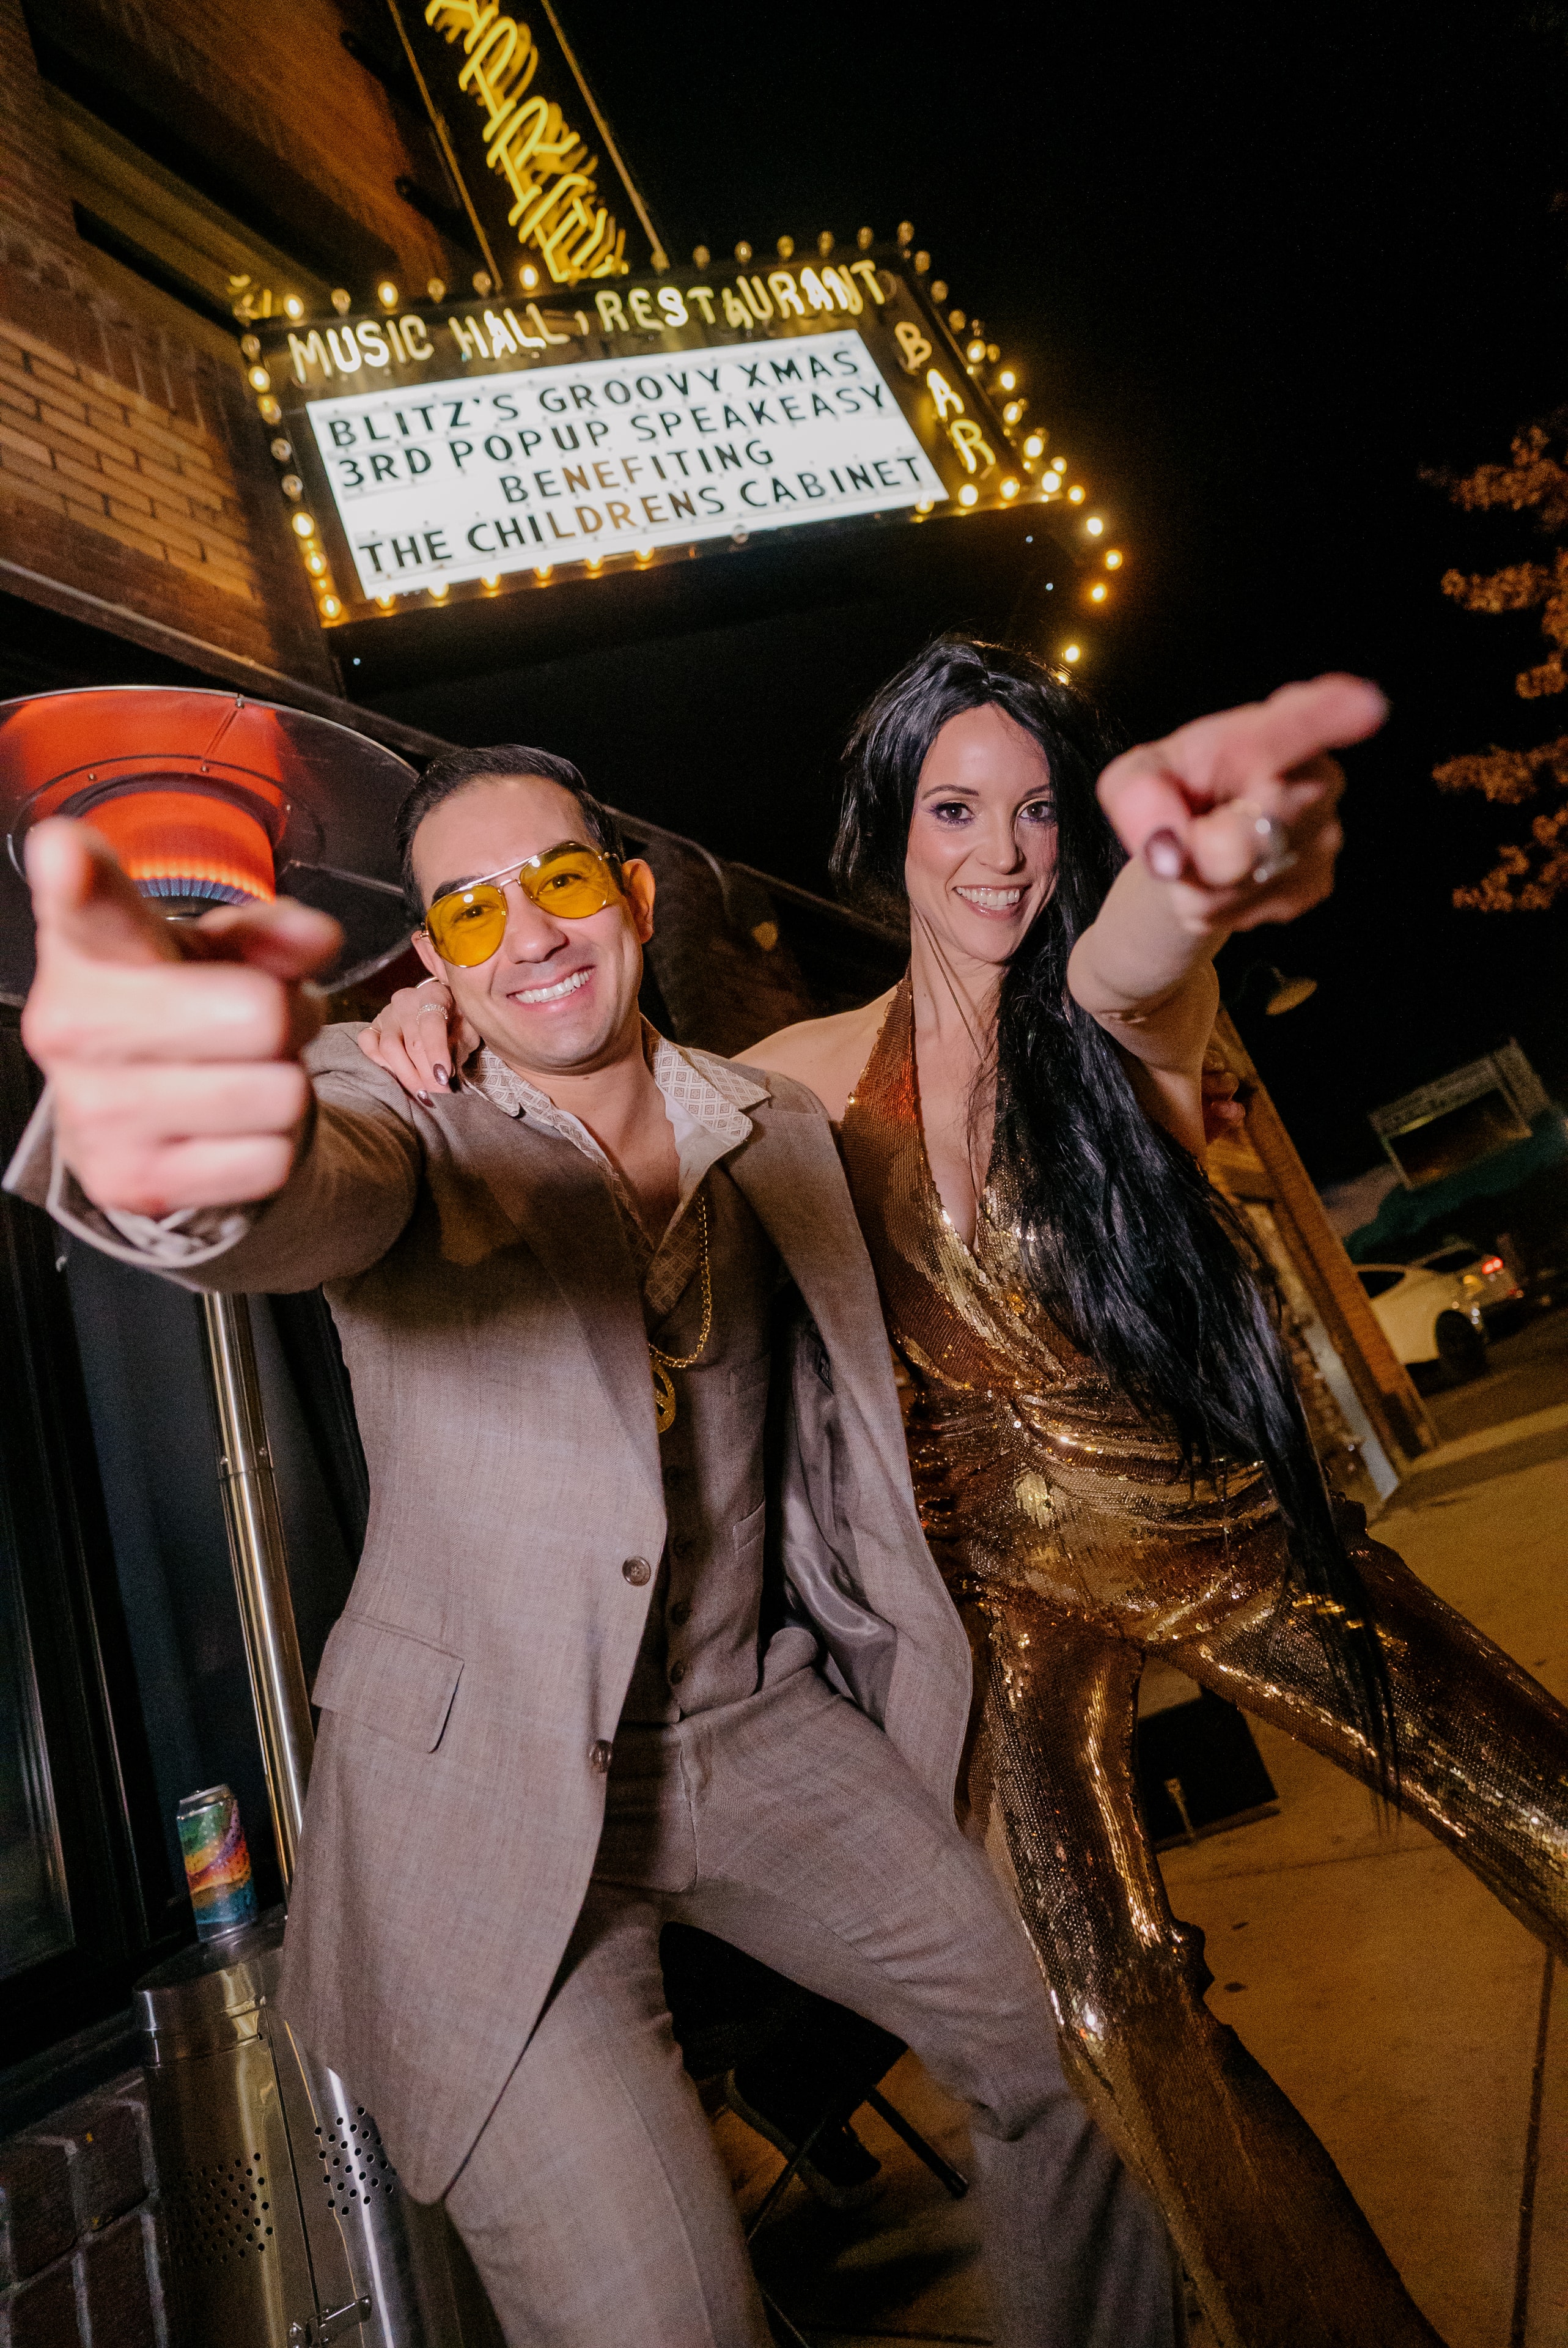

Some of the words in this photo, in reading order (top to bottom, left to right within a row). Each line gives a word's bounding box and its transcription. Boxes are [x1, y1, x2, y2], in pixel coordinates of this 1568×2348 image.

[287, 314, 434, 383] MUSIC
[595, 260, 885, 332] RESTAURANT
[328, 394, 518, 448] BLITZ'S
[539, 367, 720, 419] GROOVY
[738, 350, 858, 388] XMAS
[338, 448, 432, 487] 3RD
[449, 416, 609, 469] POPUP
[630, 383, 886, 441] SPEAKEASY
[894, 321, 997, 474] BAR
[359, 529, 452, 572] THE
[467, 487, 725, 553] CHILDRENS
[739, 456, 921, 508] CABINET
[499, 439, 774, 503] BENEFITING
